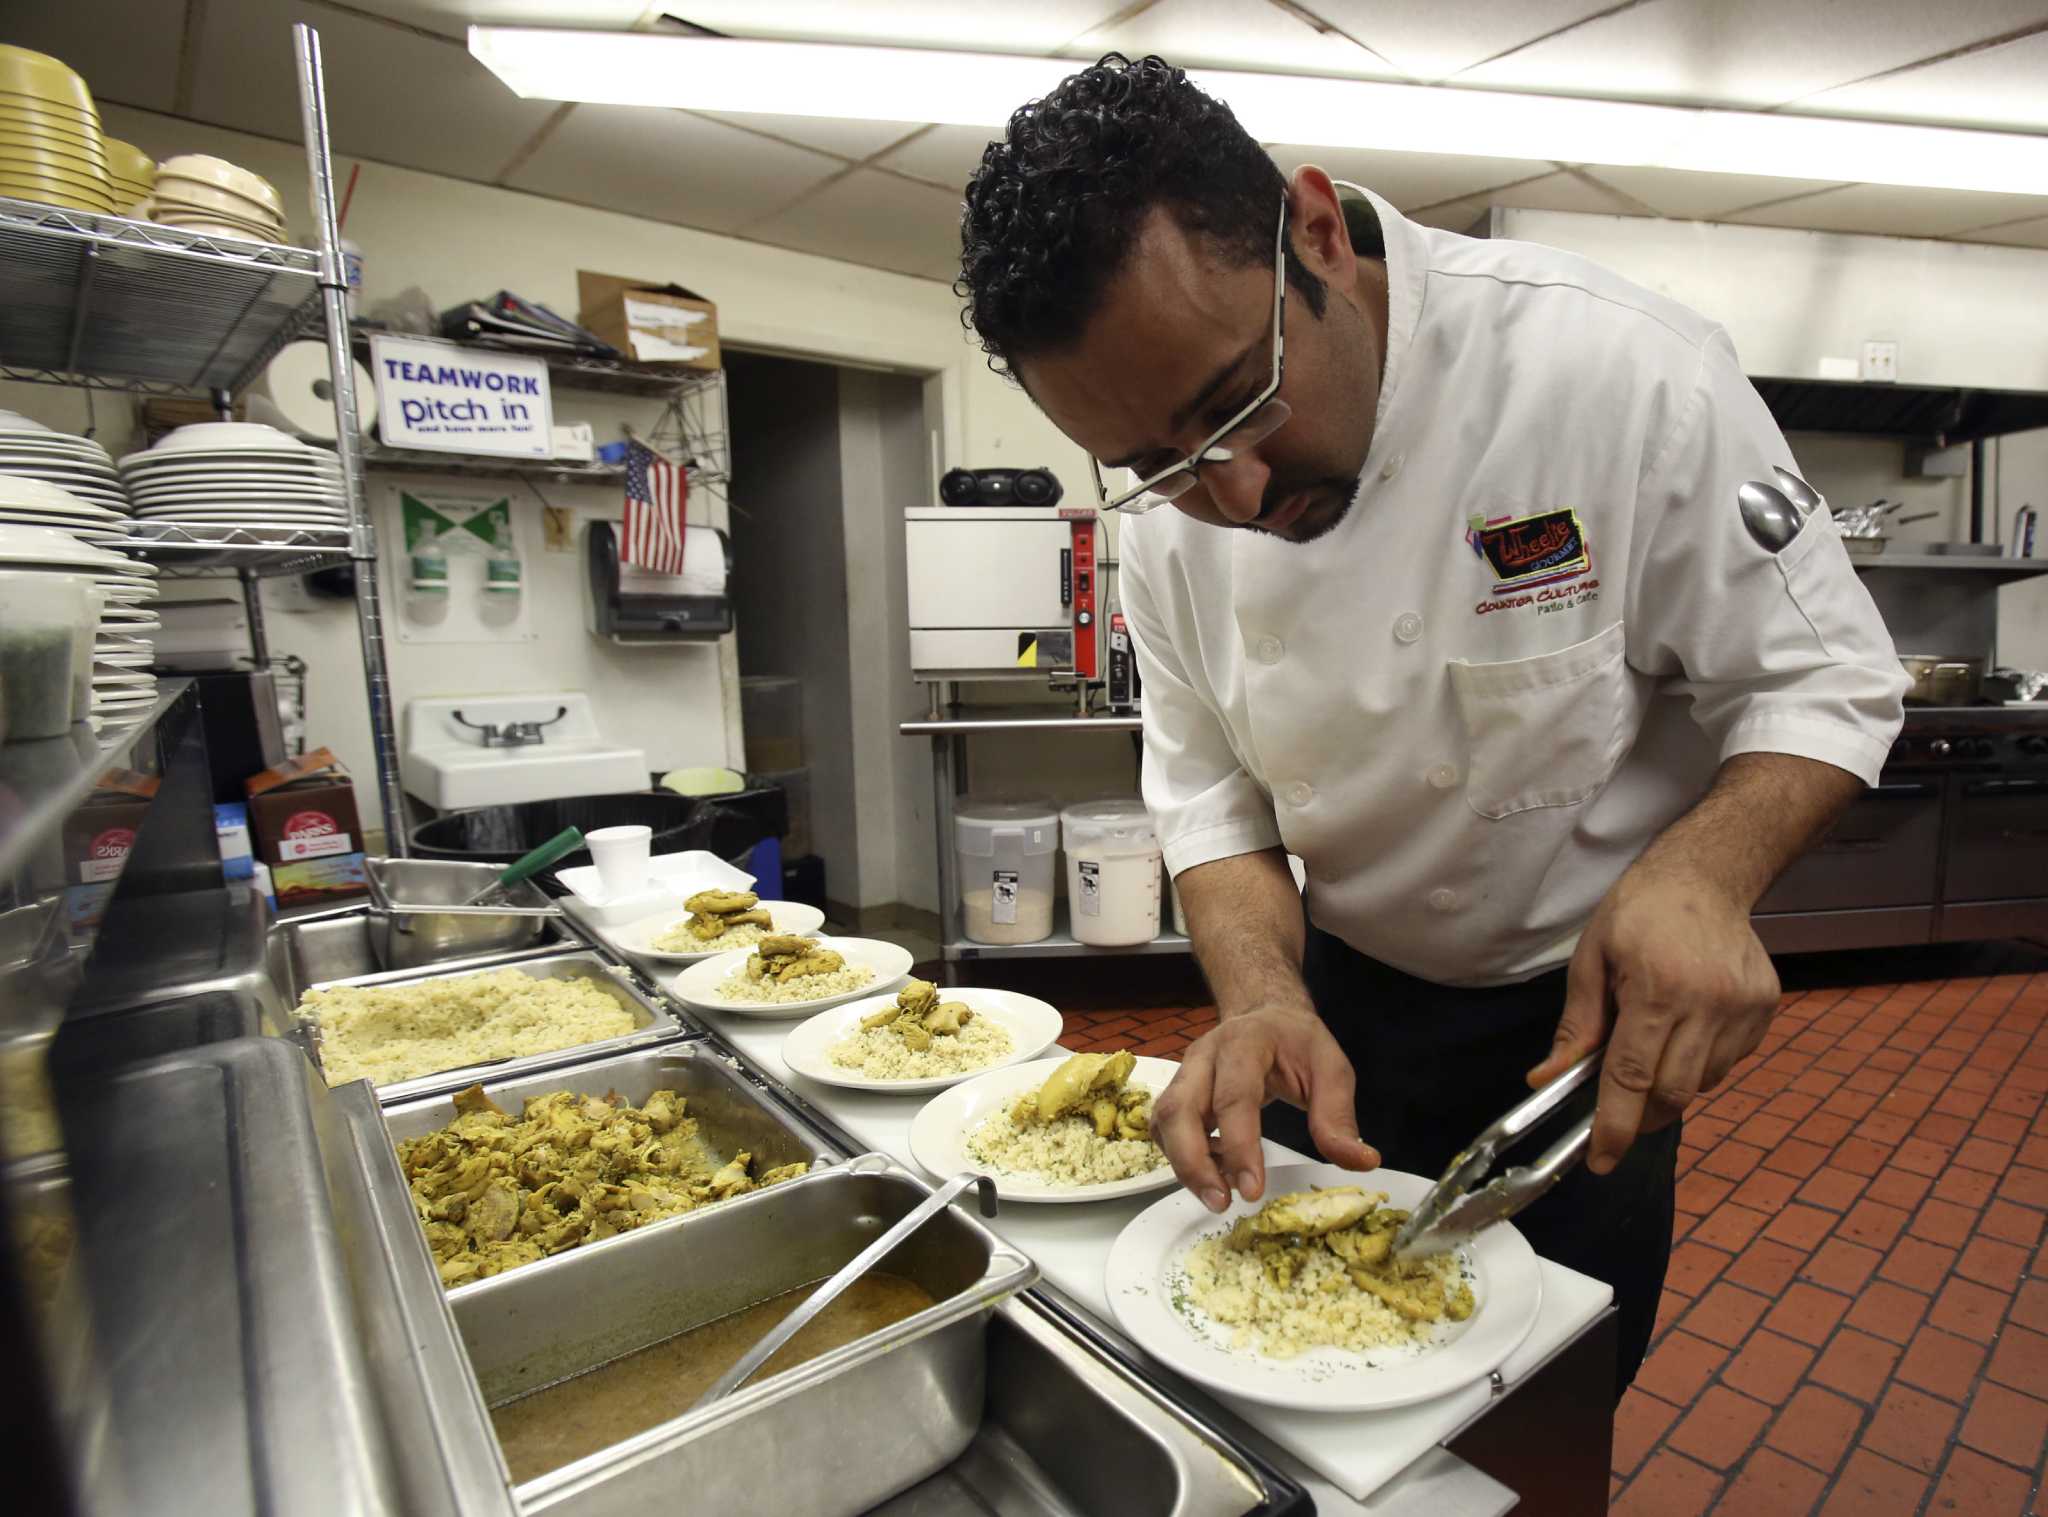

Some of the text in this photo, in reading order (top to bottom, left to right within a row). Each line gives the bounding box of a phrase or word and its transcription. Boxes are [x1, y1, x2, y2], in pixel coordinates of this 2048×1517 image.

[385, 359, 539, 395] TEAMWORK
[401, 397, 529, 430] pitch in
[1537, 601, 1564, 617] Patio
